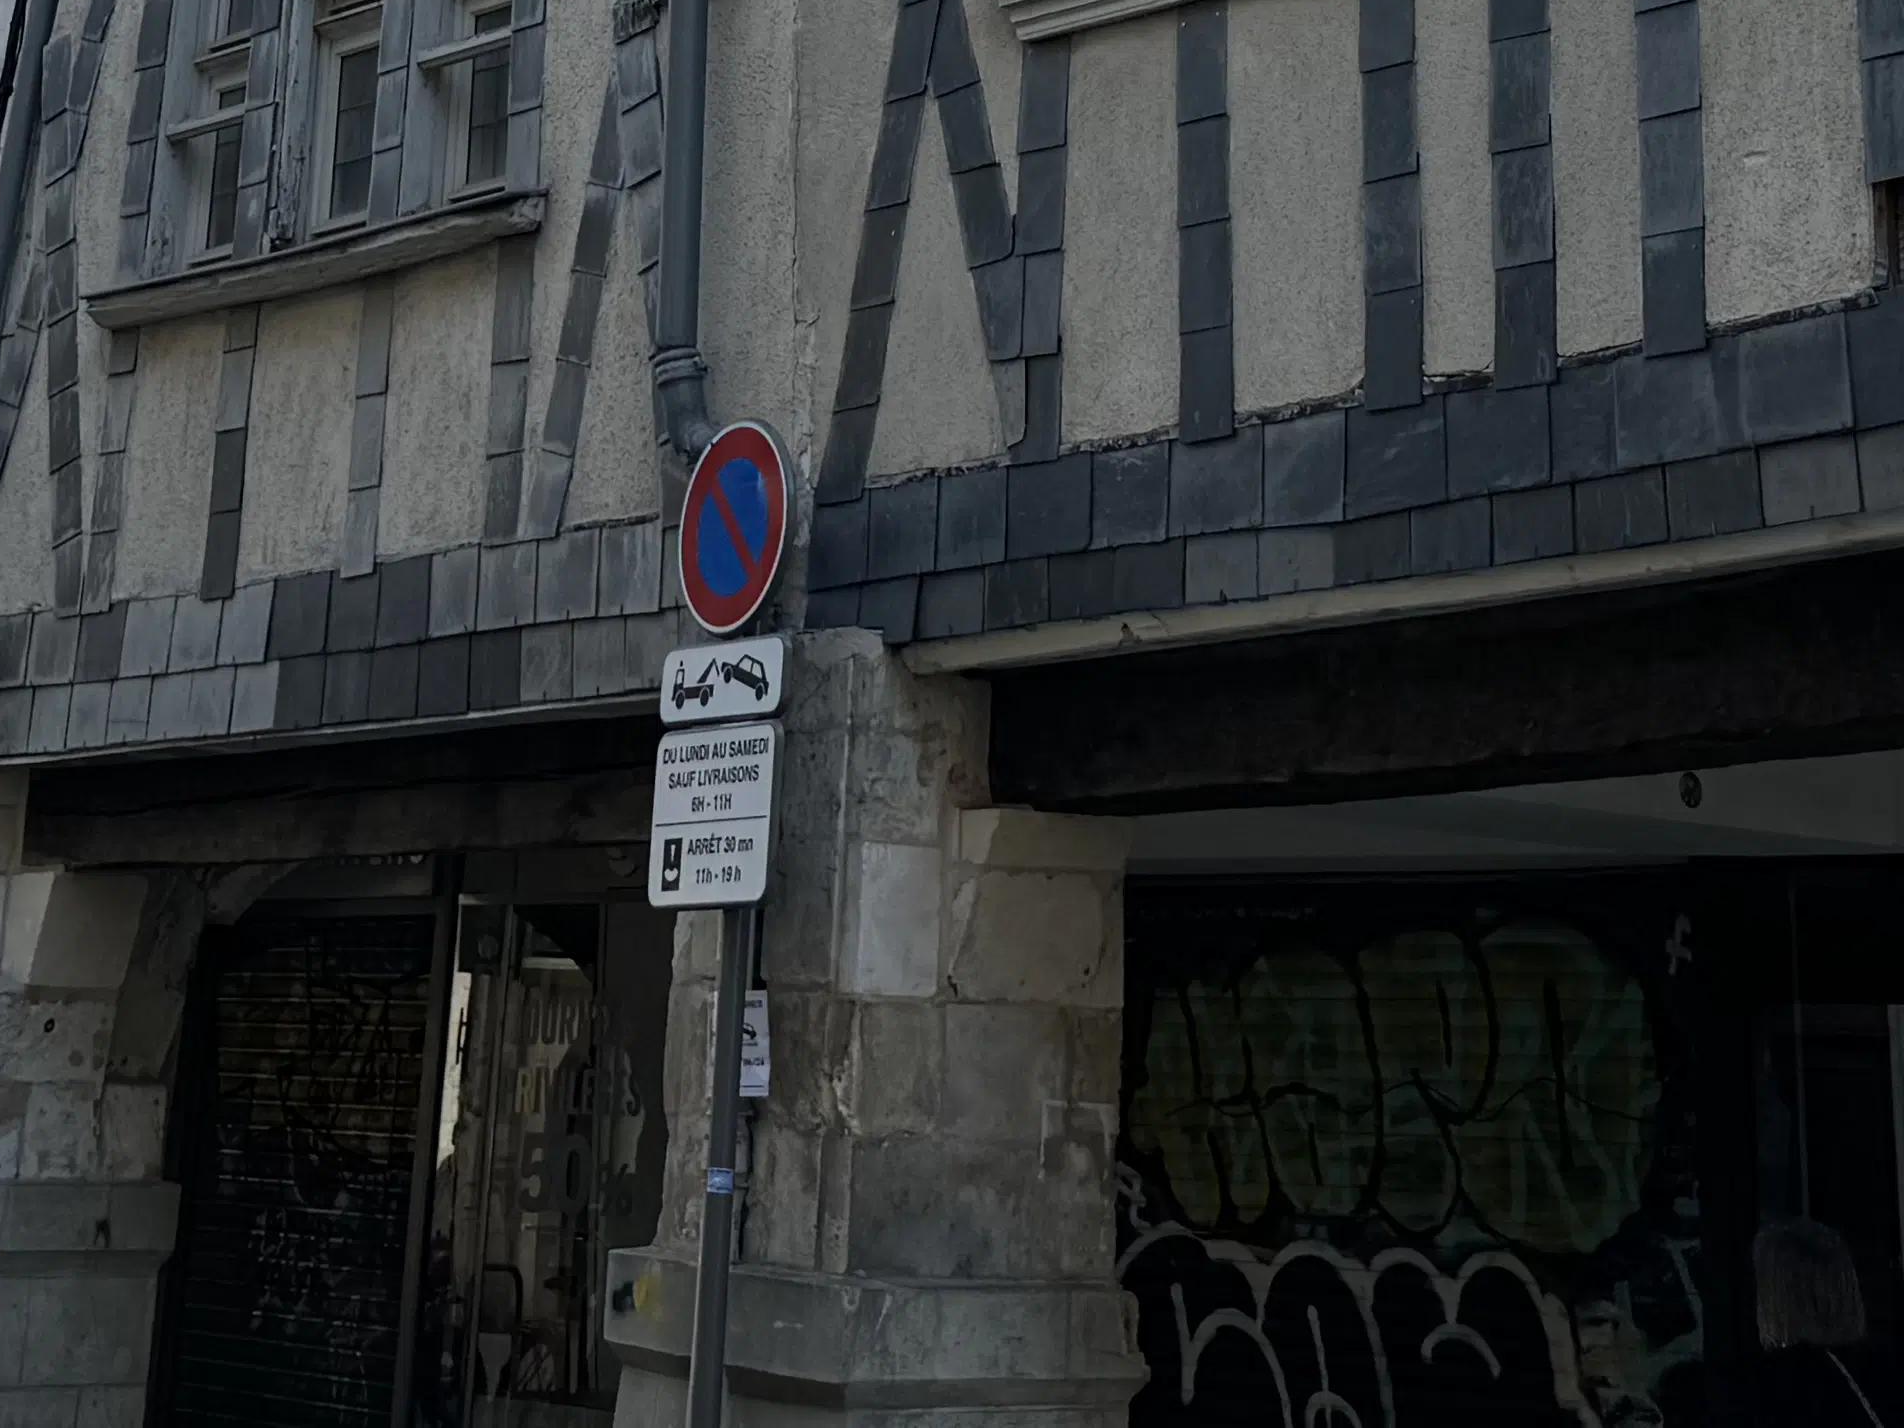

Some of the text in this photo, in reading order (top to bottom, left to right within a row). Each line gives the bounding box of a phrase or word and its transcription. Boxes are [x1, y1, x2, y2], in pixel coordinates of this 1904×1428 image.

[663, 737, 769, 764] DU LUNDI AU SAMEDI
[668, 764, 760, 789] SAUF LIVRAISONS
